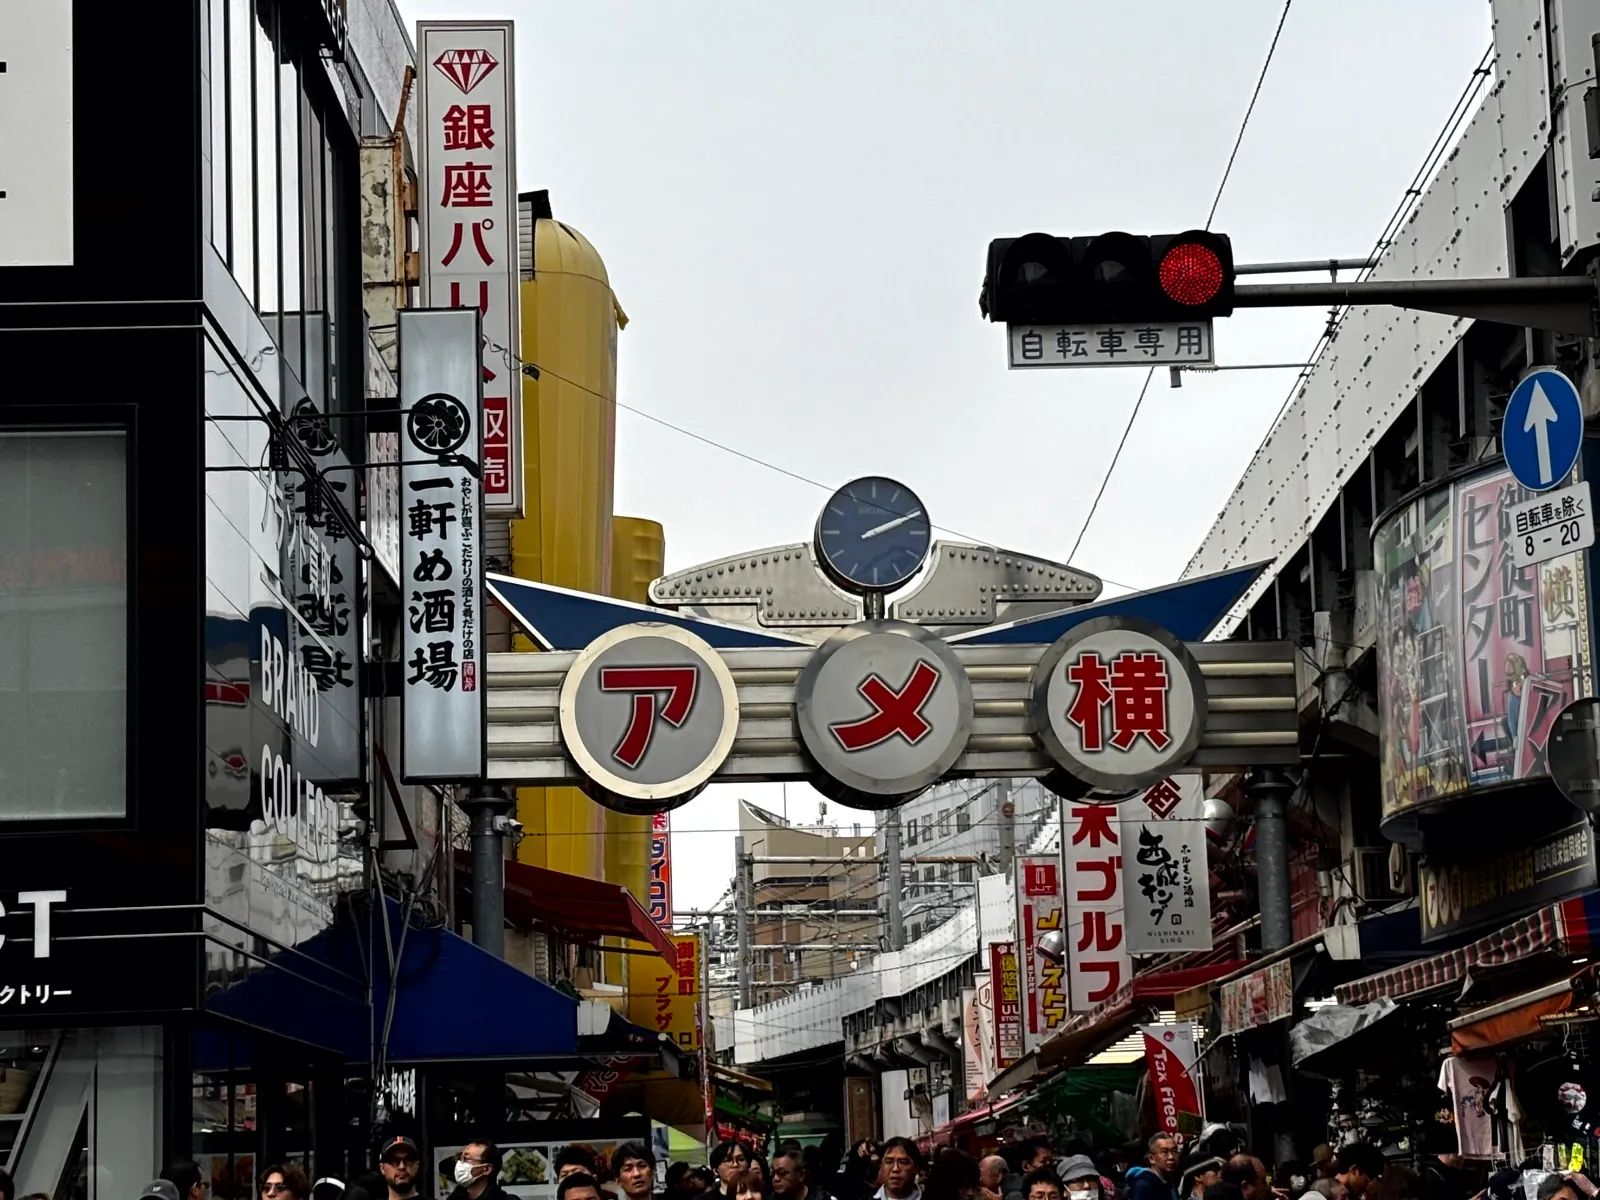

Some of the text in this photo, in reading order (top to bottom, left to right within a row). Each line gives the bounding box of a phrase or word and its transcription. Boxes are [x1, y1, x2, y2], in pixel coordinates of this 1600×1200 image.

[440, 104, 497, 382] 銀座パリ
[1021, 327, 1202, 359] 自転車専用
[1516, 495, 1584, 533] 自転車を除く
[407, 476, 458, 692] 一軒め酒場
[1463, 494, 1495, 716] センター
[261, 624, 319, 748] BRAND
[601, 653, 1170, 769] アメ横
[262, 743, 338, 869] COLLECT
[1071, 804, 1122, 1002] 木ゴルフ
[1136, 823, 1180, 925] 西成キング
[655, 975, 673, 1031] プラザ
[677, 941, 695, 996] 御徒町
[1153, 1048, 1168, 1082] Tax
[1160, 1086, 1178, 1129] Free
